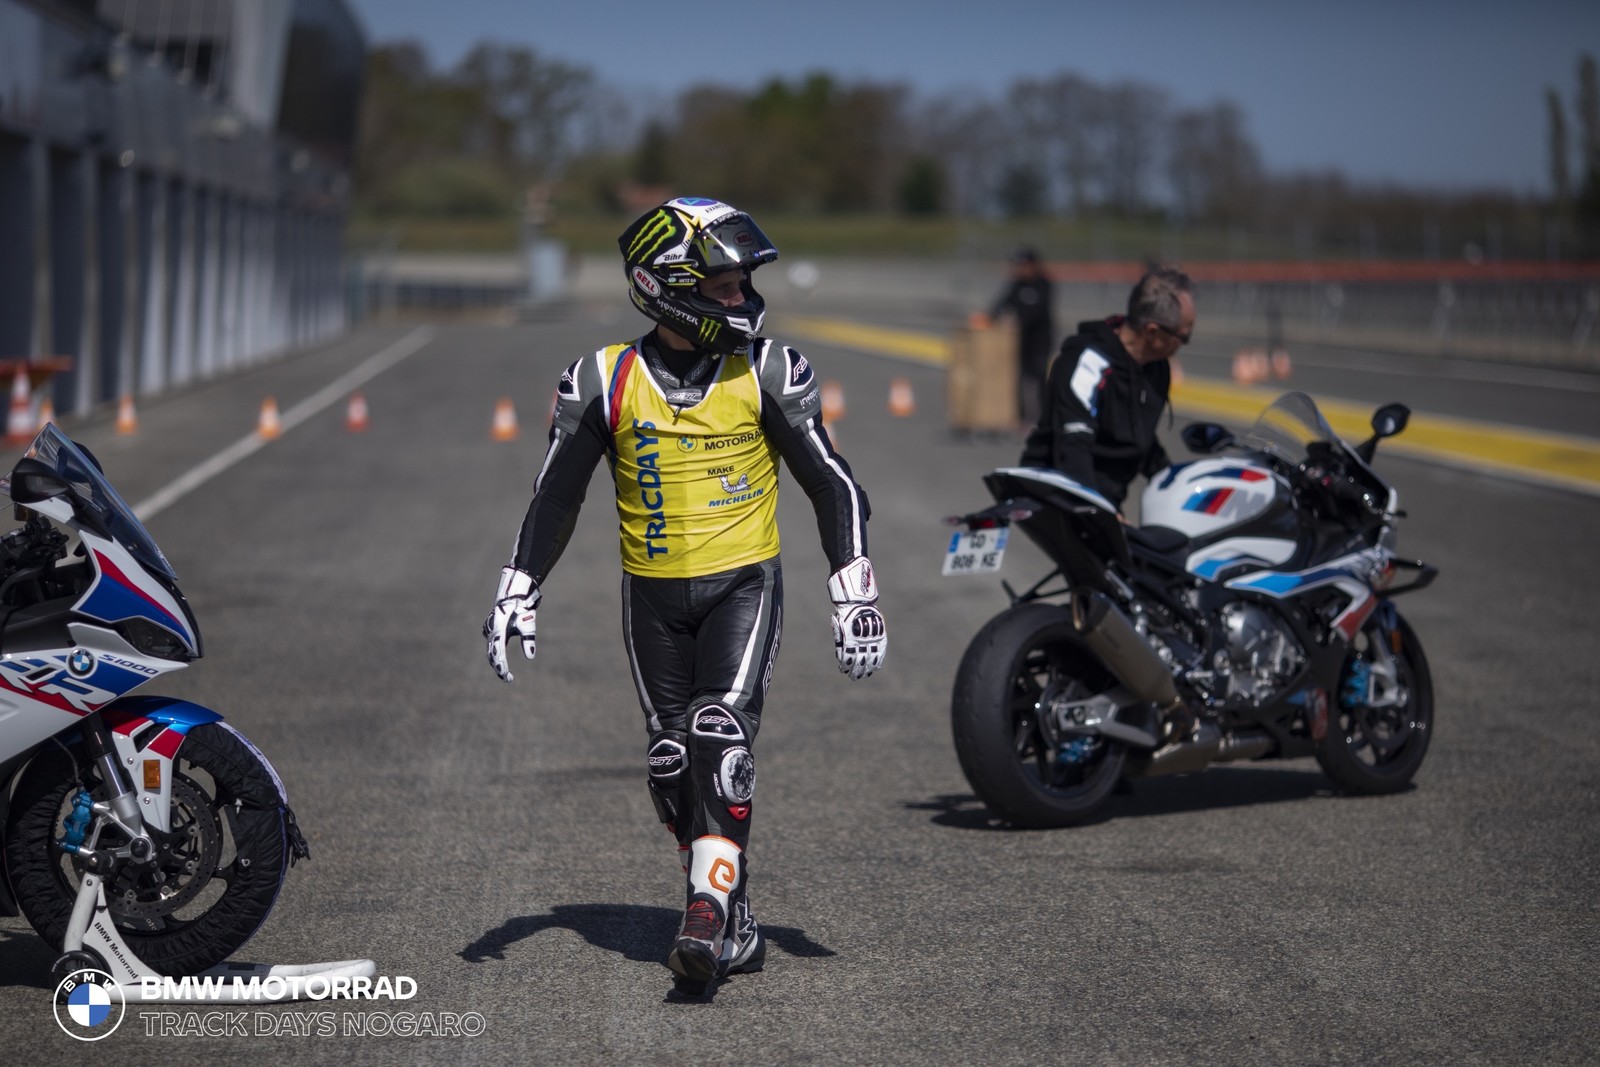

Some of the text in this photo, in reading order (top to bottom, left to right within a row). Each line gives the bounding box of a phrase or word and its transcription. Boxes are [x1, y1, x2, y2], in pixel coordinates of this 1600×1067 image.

[636, 271, 655, 293] BELL
[656, 298, 699, 326] MONSTER
[707, 465, 735, 476] MAKE
[708, 487, 765, 508] MICHELIN
[99, 654, 159, 675] S1000
[696, 716, 735, 726] RST
[94, 922, 139, 980] BMW Motorrad
